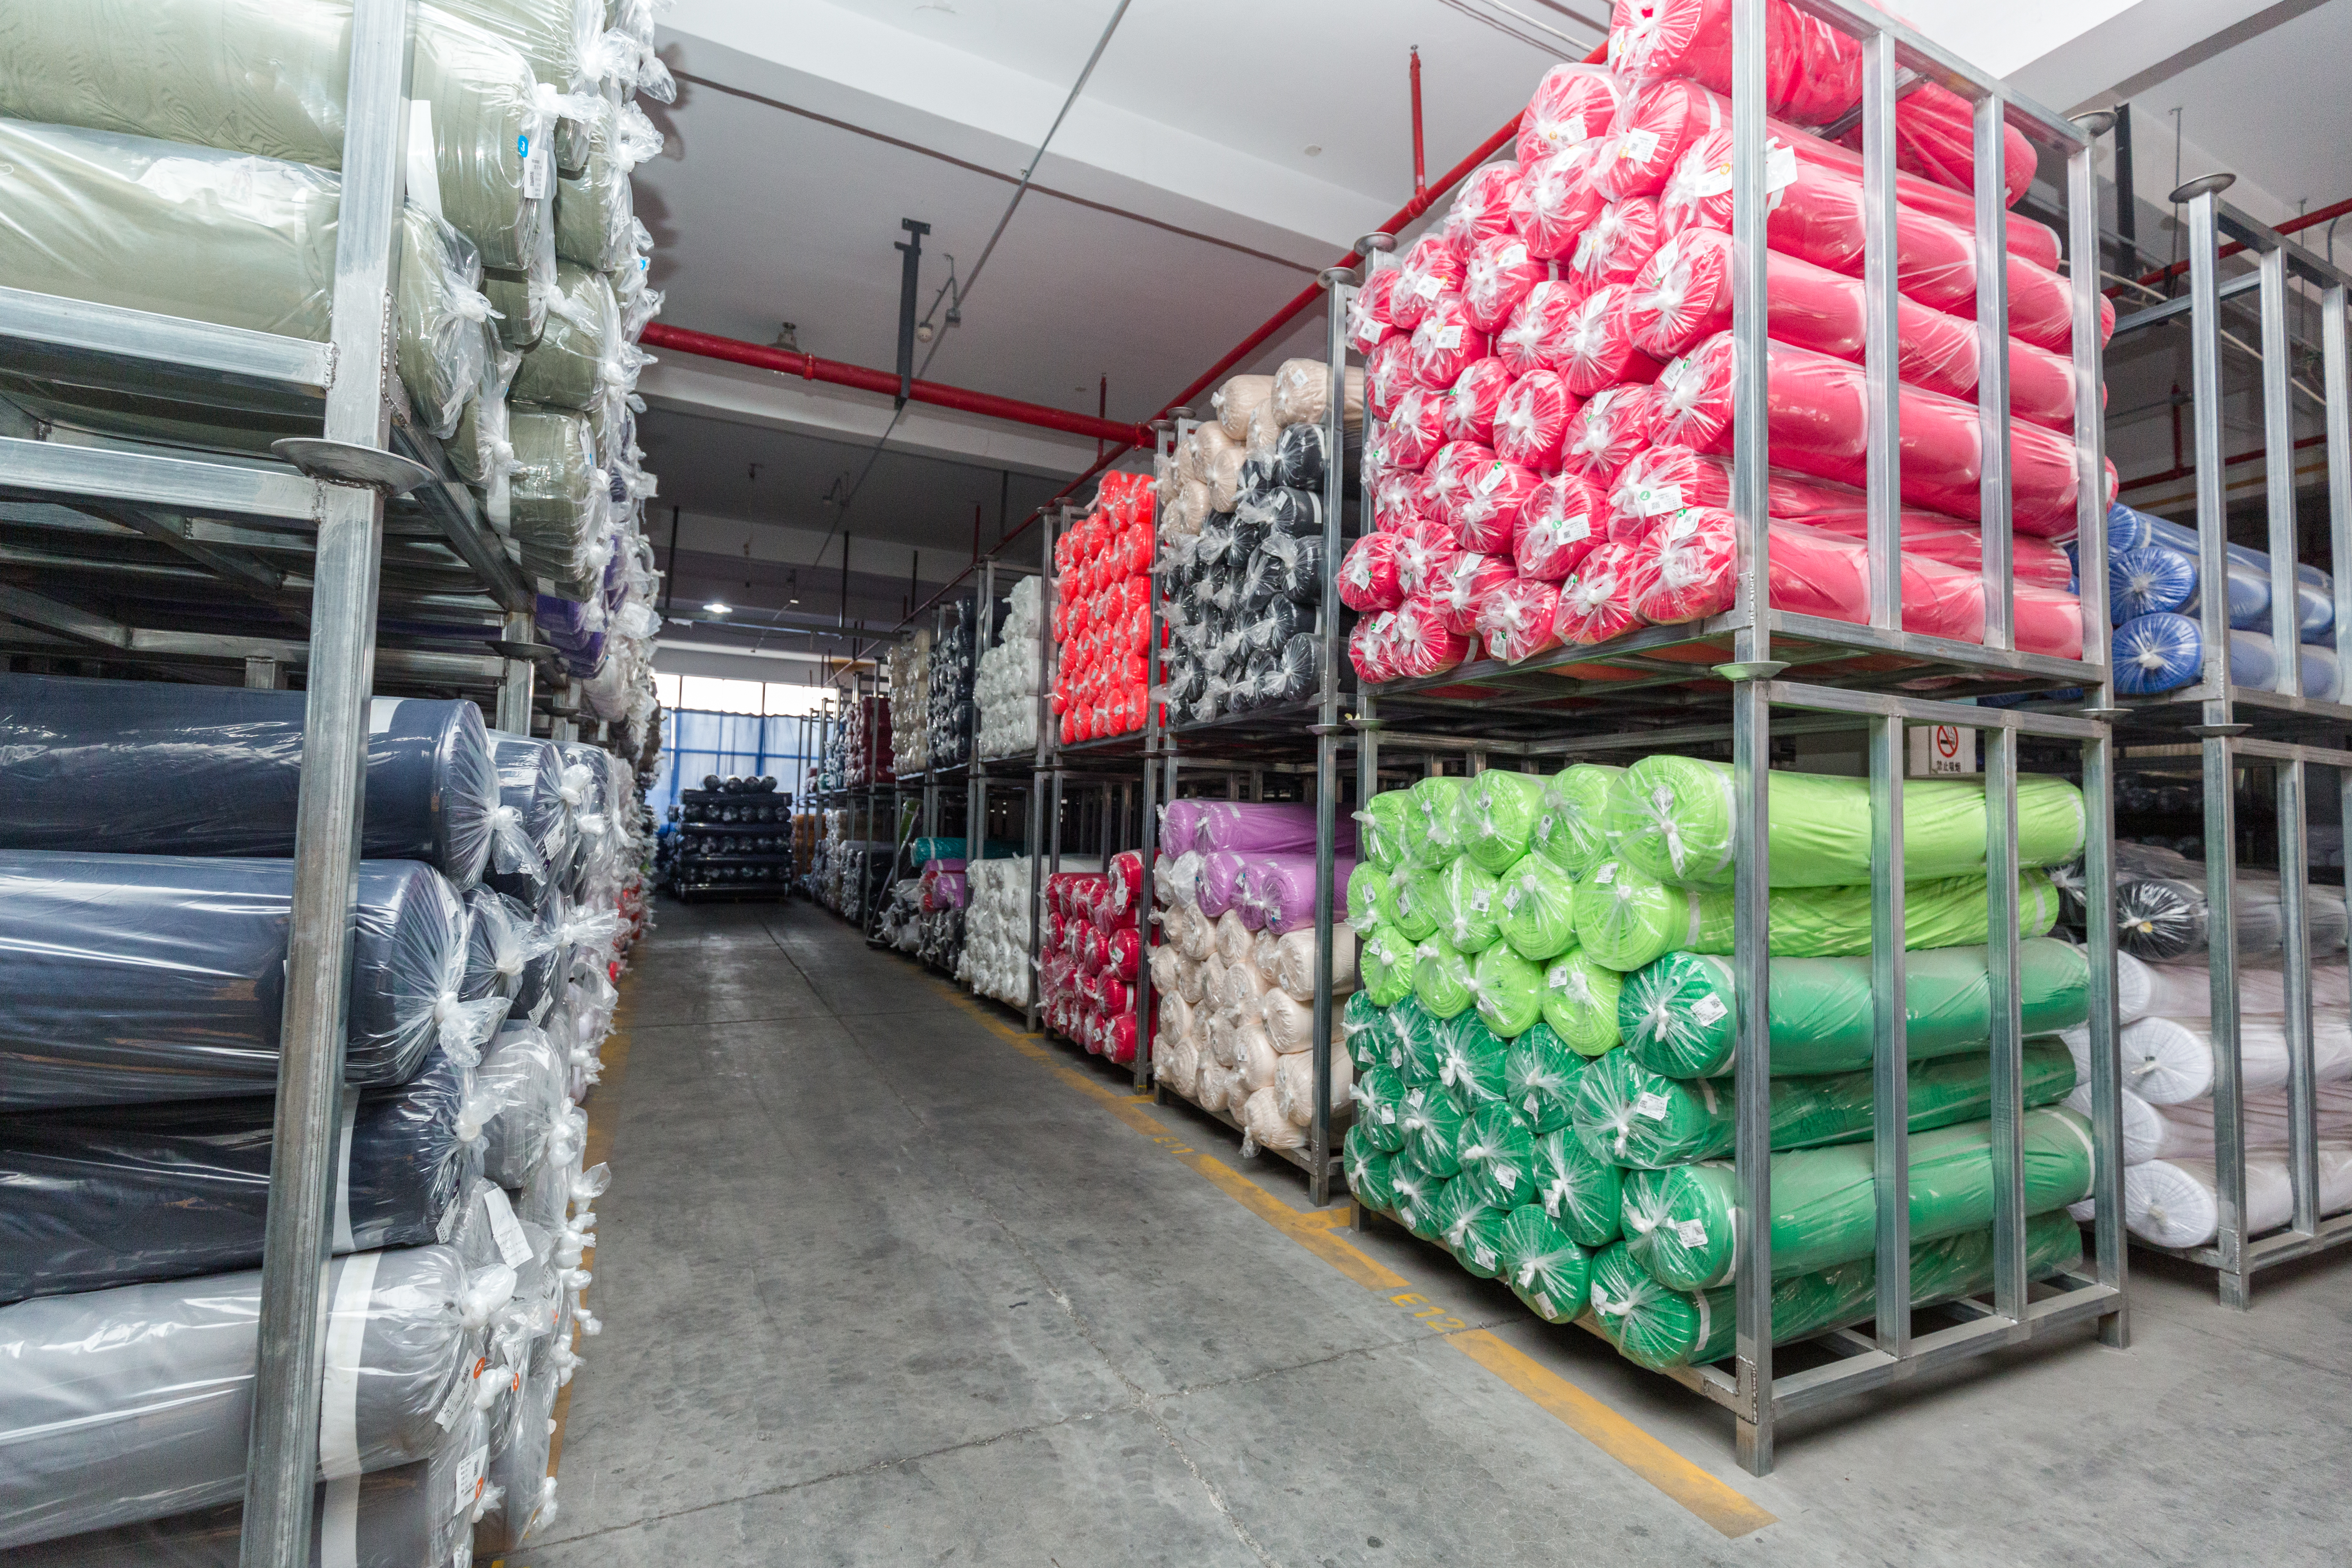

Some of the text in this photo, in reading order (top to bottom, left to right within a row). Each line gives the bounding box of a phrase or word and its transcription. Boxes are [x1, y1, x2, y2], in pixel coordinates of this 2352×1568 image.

[521, 141, 526, 151] 3
[1936, 760, 1961, 772] 禁止吸烟
[1389, 1293, 1466, 1332] E12
